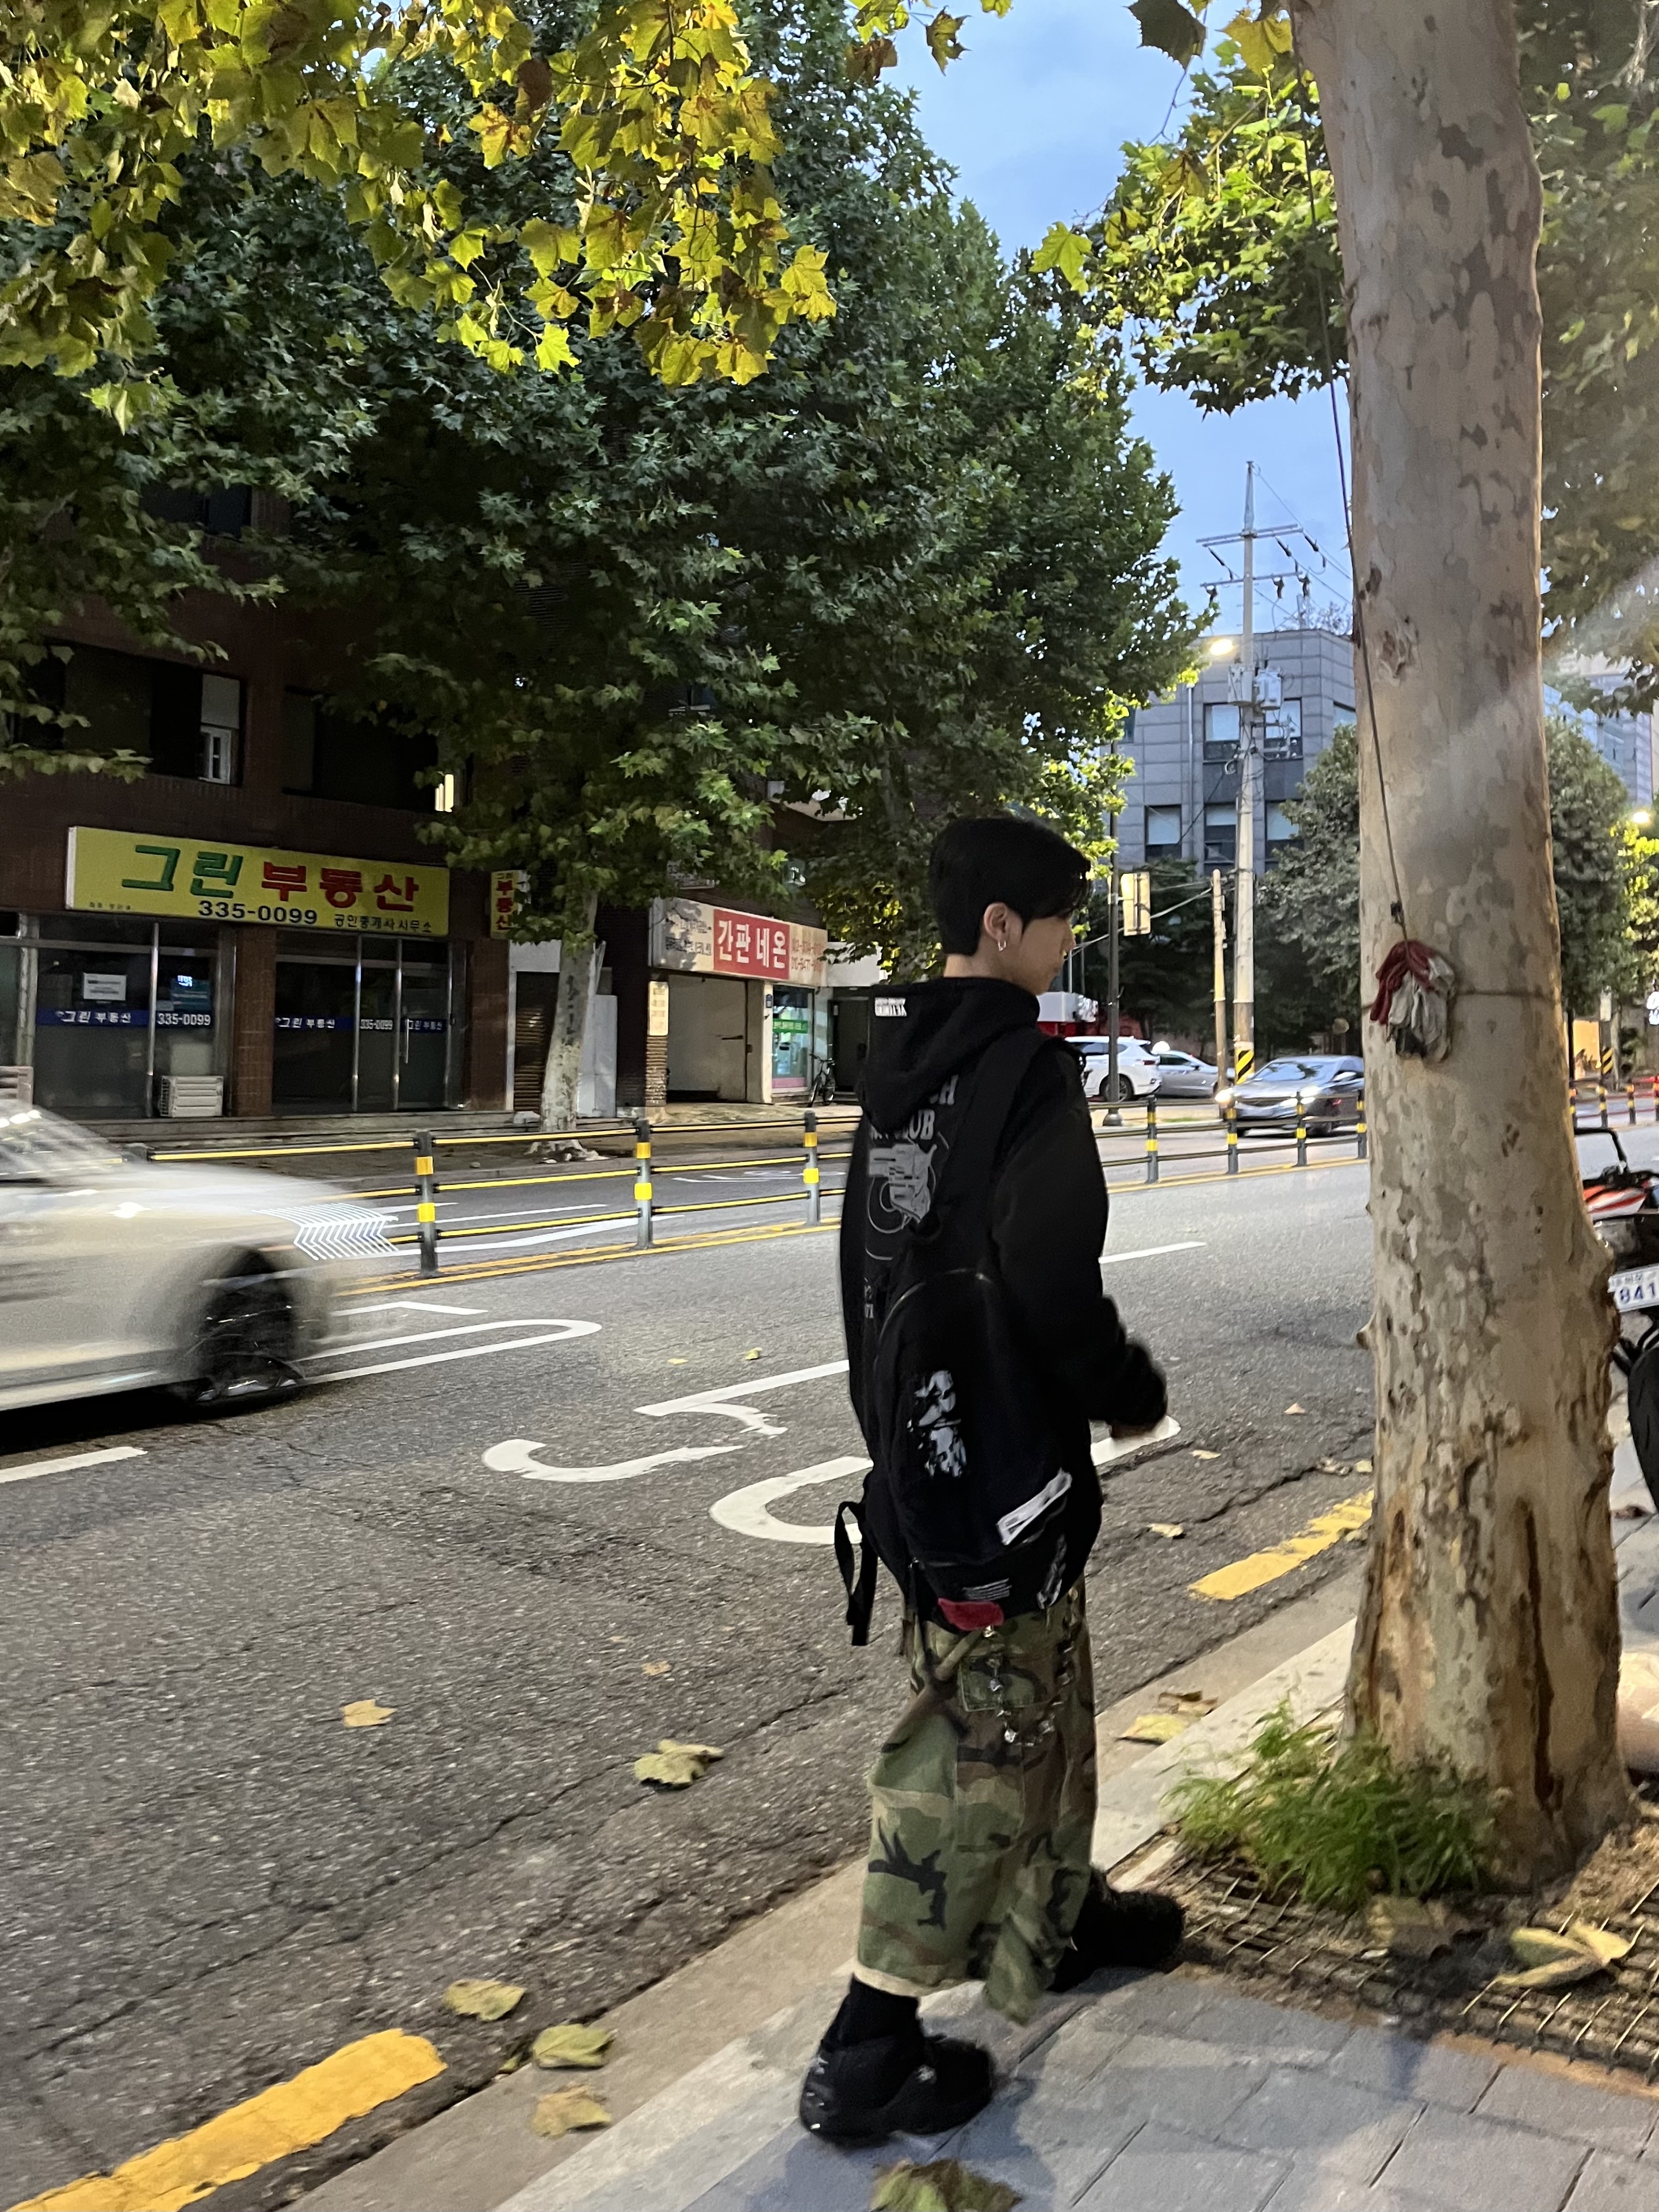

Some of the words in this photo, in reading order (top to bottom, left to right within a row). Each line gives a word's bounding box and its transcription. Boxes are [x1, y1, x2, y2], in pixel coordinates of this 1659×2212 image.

[121, 845, 243, 898] 그린
[261, 861, 419, 912] 부동산
[198, 900, 318, 924] 335-0099
[718, 920, 751, 964] 간판
[756, 927, 787, 969] 네온
[61, 1010, 91, 1023] 그린
[95, 1011, 132, 1024] 부동산
[157, 1013, 211, 1026] 335-0099
[278, 1017, 303, 1029] 그린
[307, 1018, 335, 1029] 부동산
[360, 1018, 393, 1030] 335-0099
